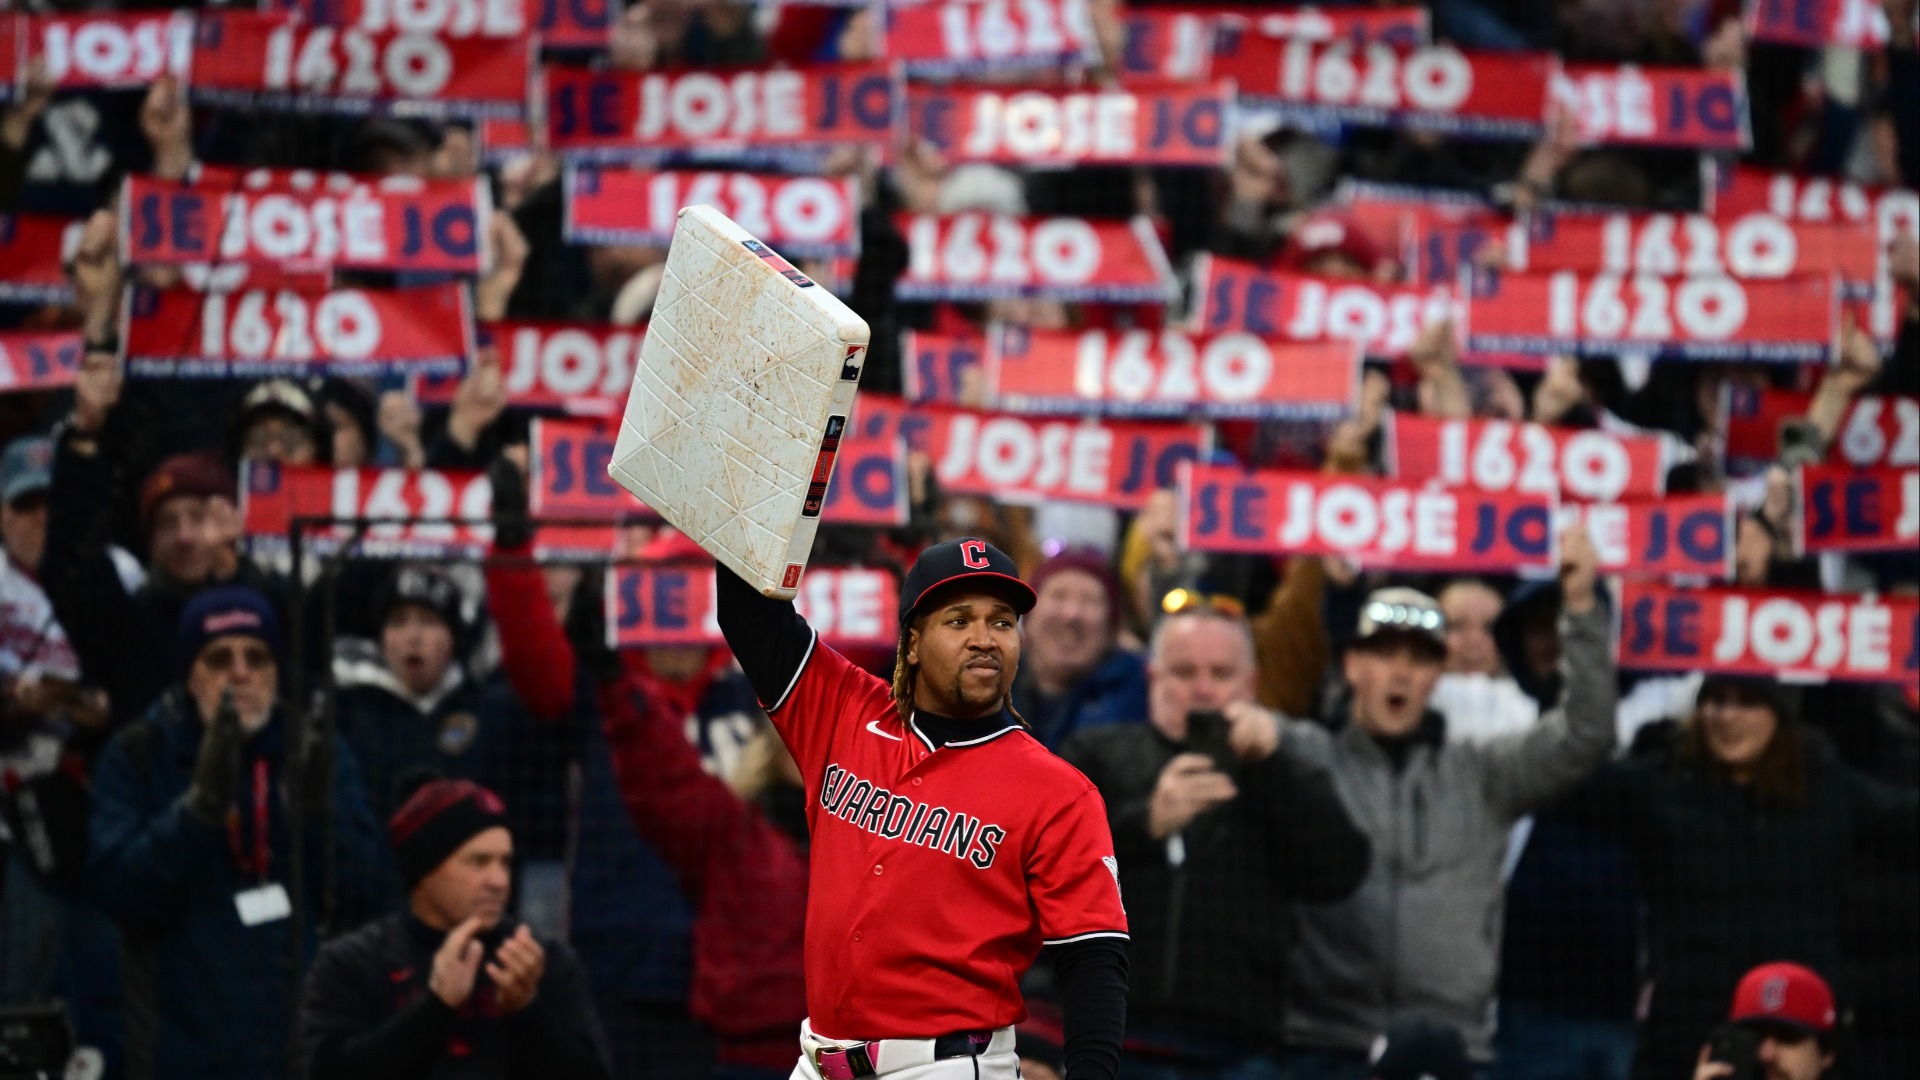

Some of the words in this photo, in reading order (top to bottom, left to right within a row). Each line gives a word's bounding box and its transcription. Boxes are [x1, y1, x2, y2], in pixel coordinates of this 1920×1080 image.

[264, 27, 452, 96] 1620
[1281, 40, 1473, 109] 1620
[817, 76, 891, 130] JO
[403, 205, 476, 256] JO
[910, 216, 1100, 281] 1620
[1604, 212, 1797, 280] 1620
[203, 290, 381, 359] 1620
[1550, 270, 1747, 340] 1620
[1075, 330, 1273, 401] 1620
[1441, 420, 1632, 499] 1620
[960, 540, 990, 570] C
[1472, 502, 1549, 554] JO
[1645, 511, 1724, 562] JO
[821, 763, 1005, 869] GUARDIANS
